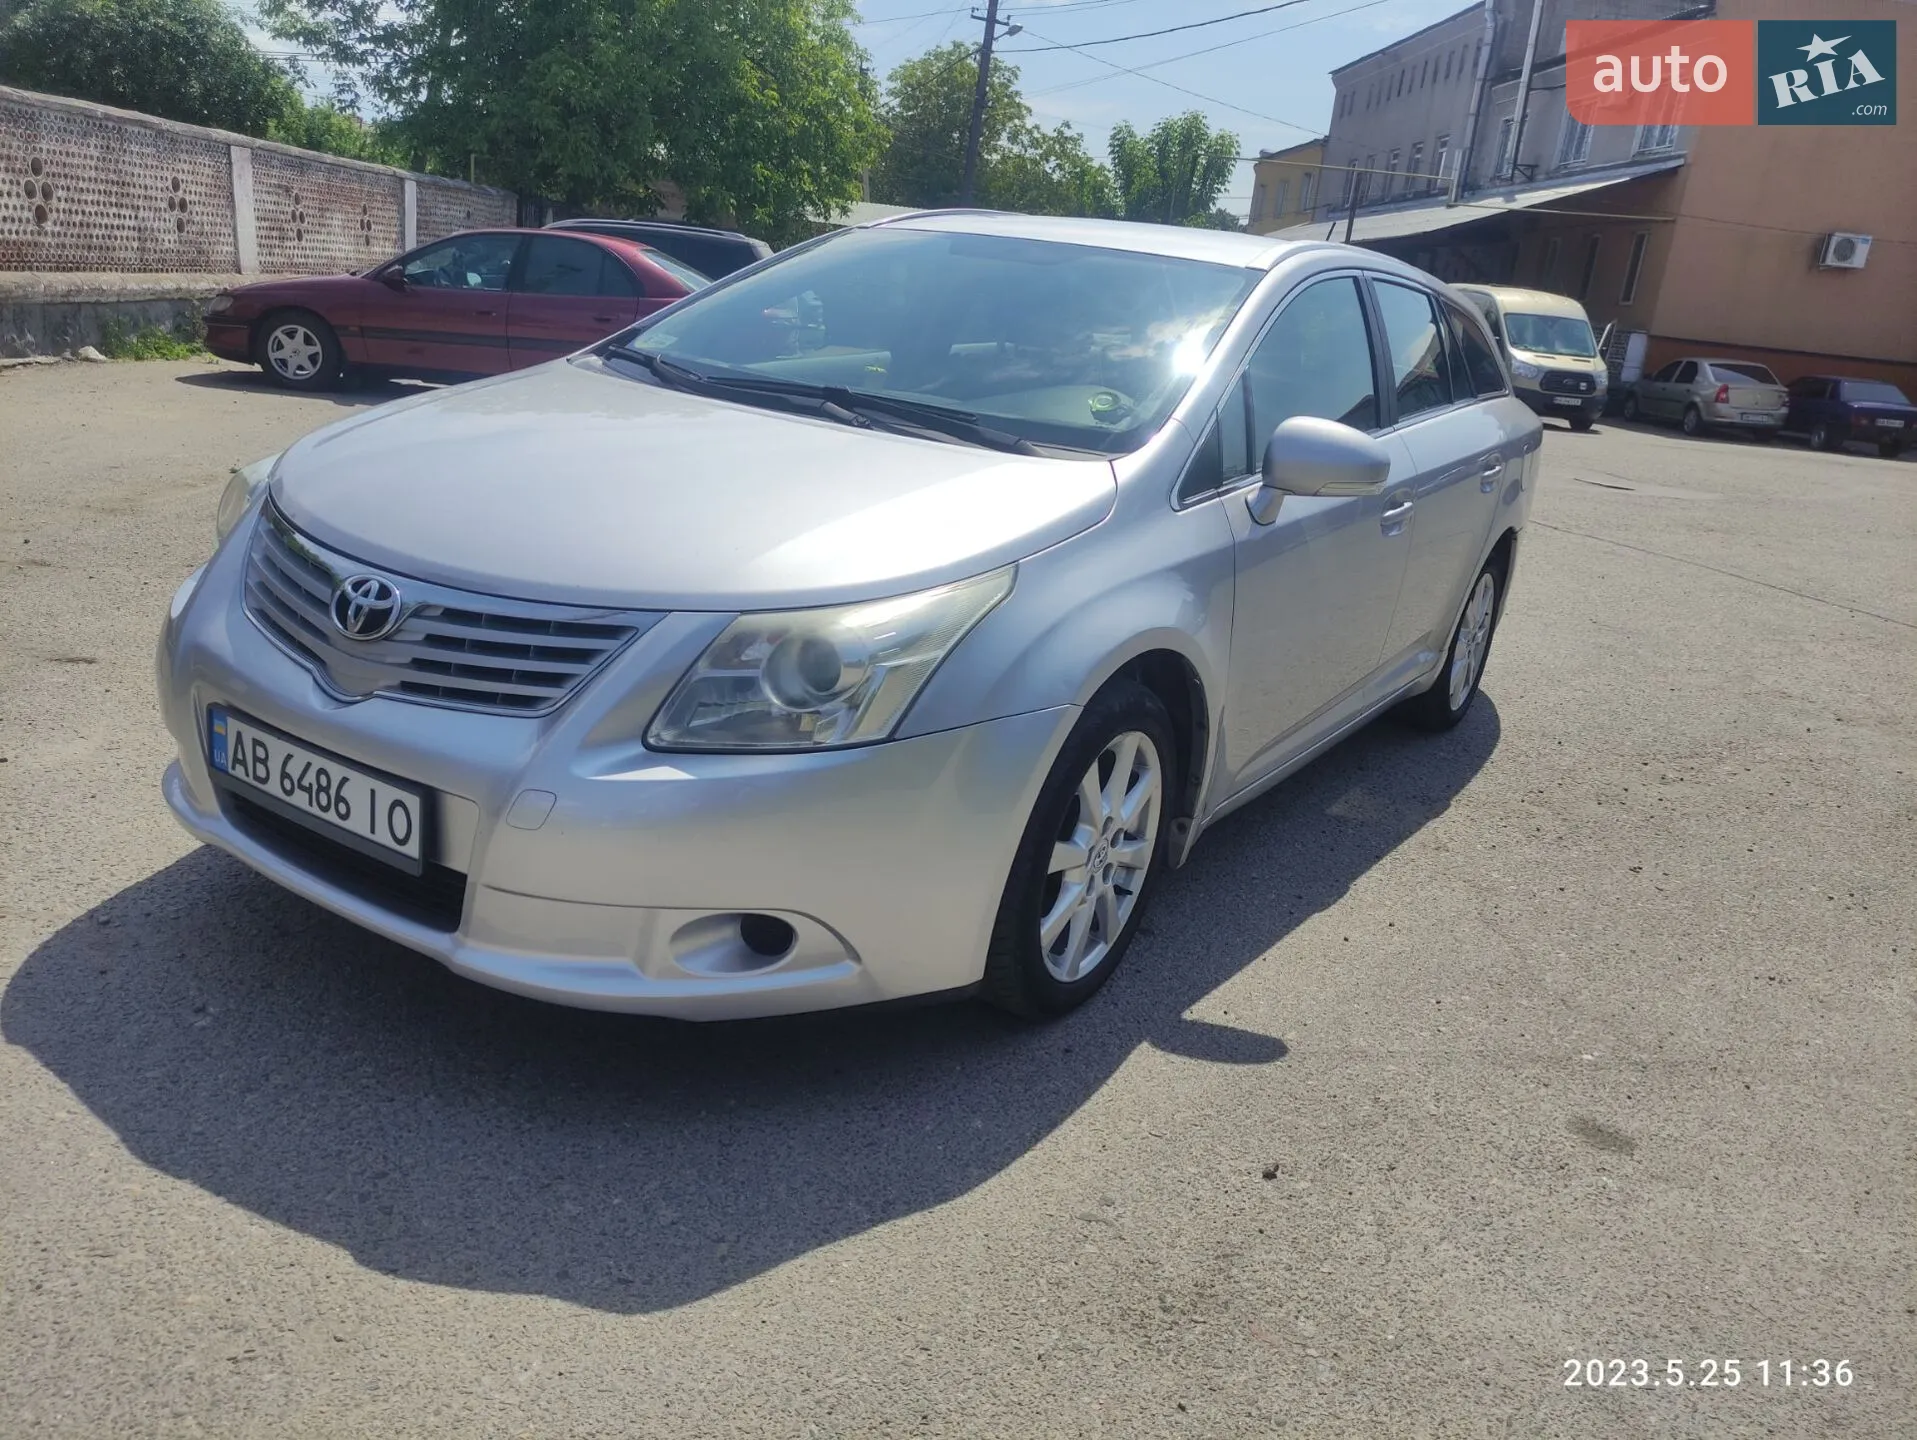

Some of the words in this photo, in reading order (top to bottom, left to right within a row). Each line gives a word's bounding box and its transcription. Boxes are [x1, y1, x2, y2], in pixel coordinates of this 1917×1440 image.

[213, 749, 227, 767] UA
[231, 730, 271, 786] AB
[279, 753, 351, 822] 6486
[369, 788, 412, 847] IO
